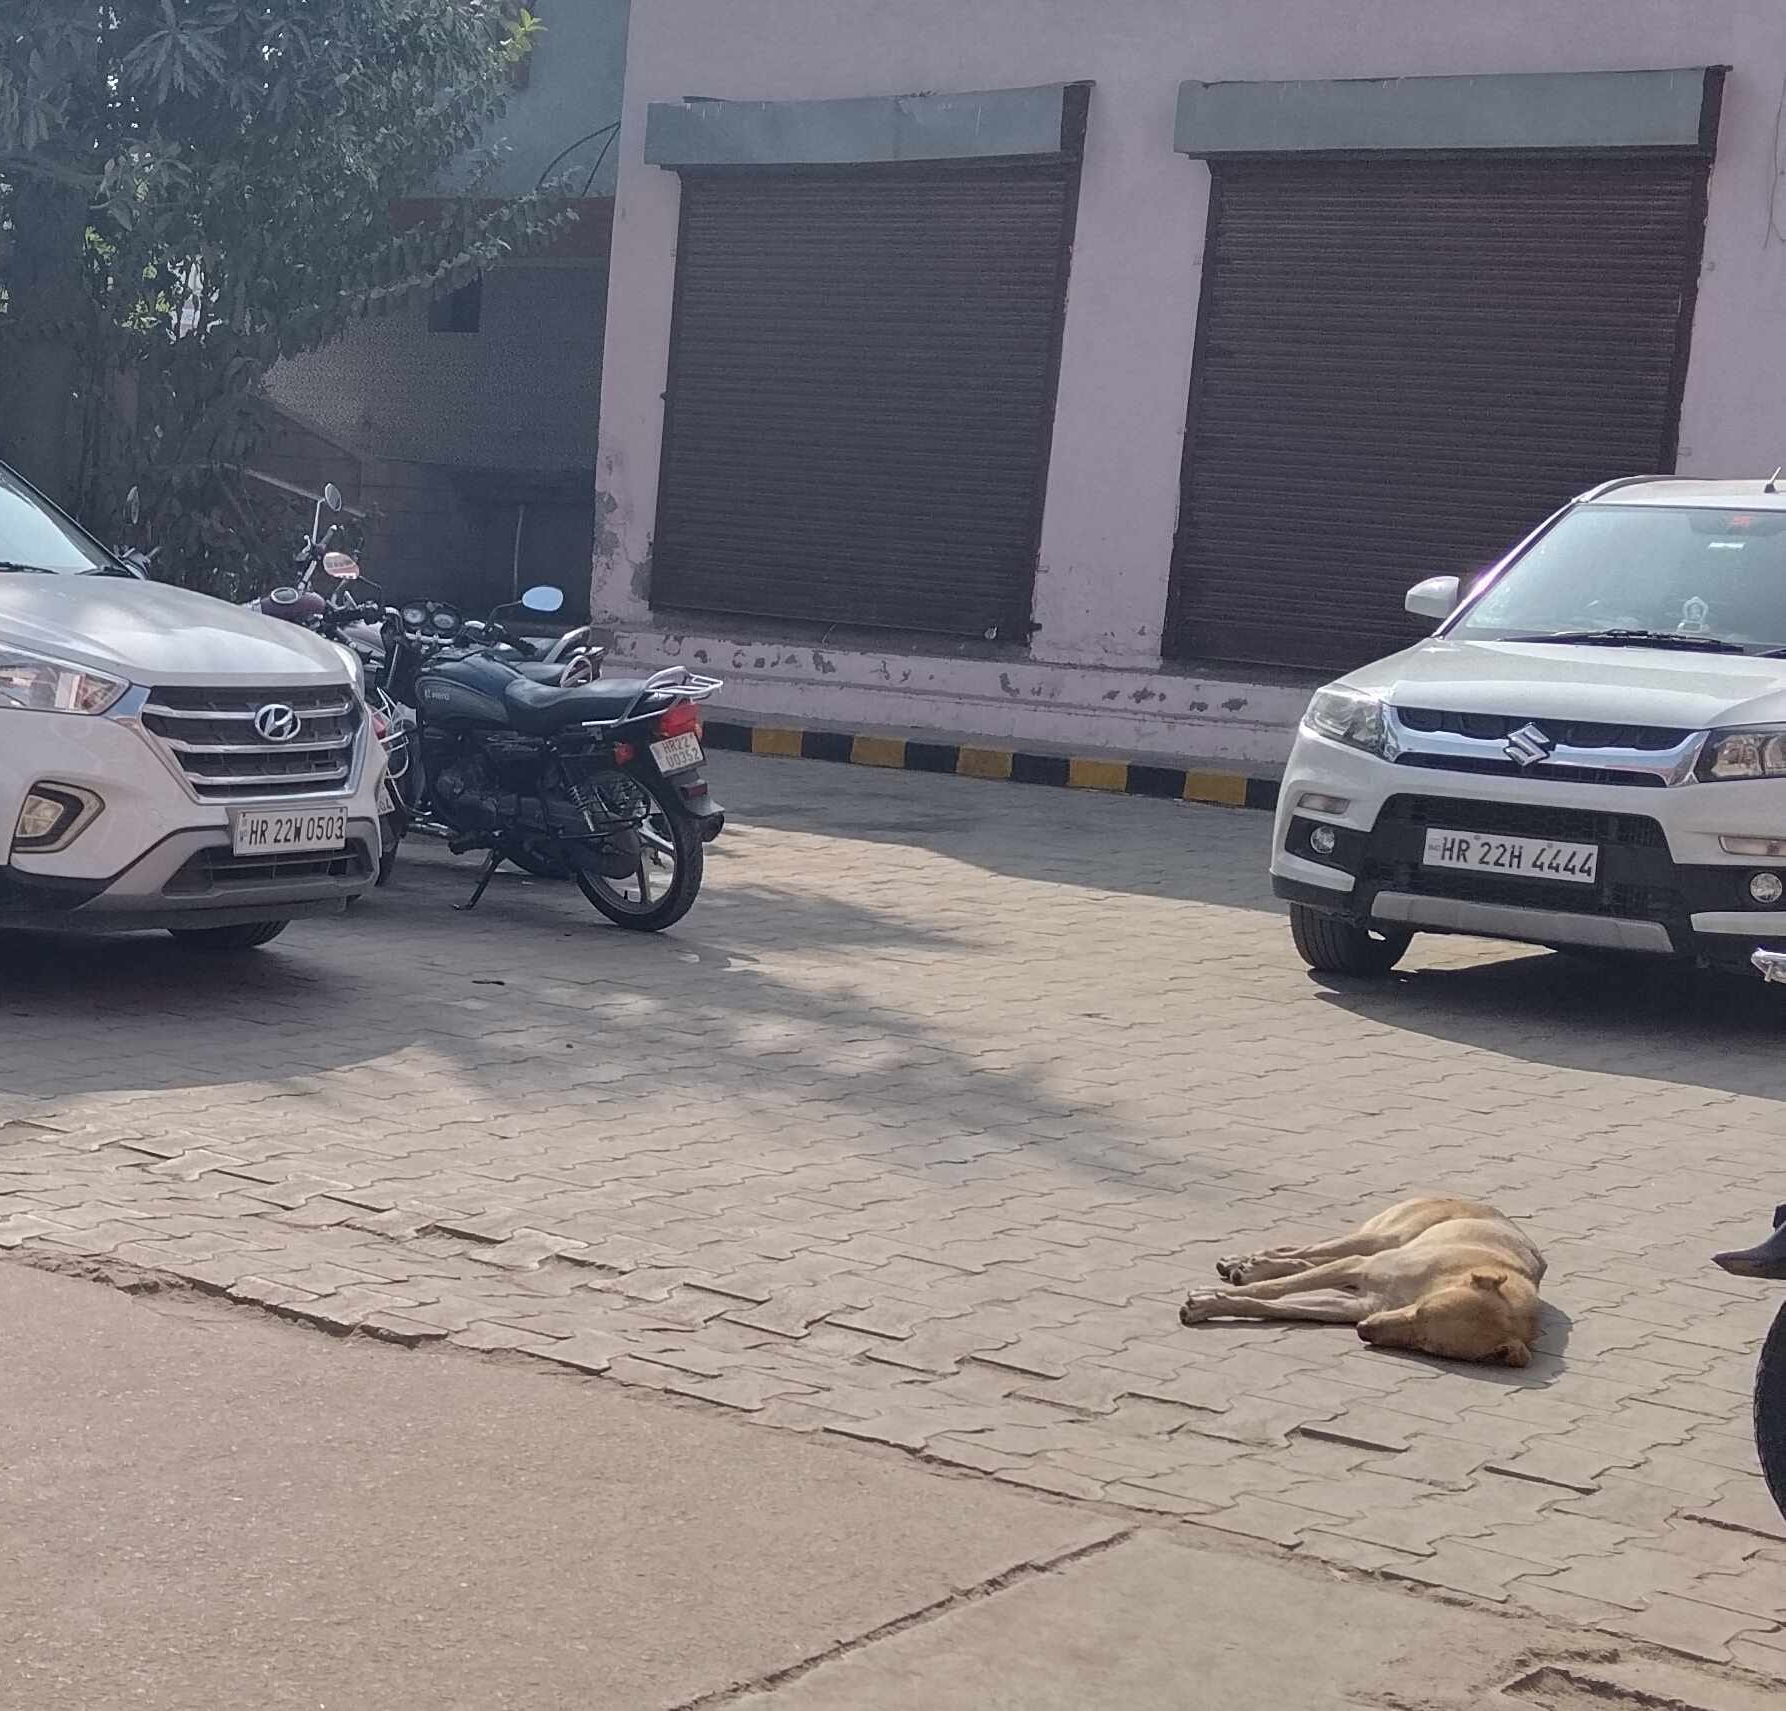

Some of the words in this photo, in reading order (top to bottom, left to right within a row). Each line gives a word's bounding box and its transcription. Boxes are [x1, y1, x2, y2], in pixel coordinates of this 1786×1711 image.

[662, 735, 691, 754] HR22
[249, 819, 269, 846] HR
[306, 815, 344, 841] 0503
[1441, 836, 1471, 864] HR
[1478, 842, 1522, 870] 22H
[1531, 847, 1594, 877] 4444
